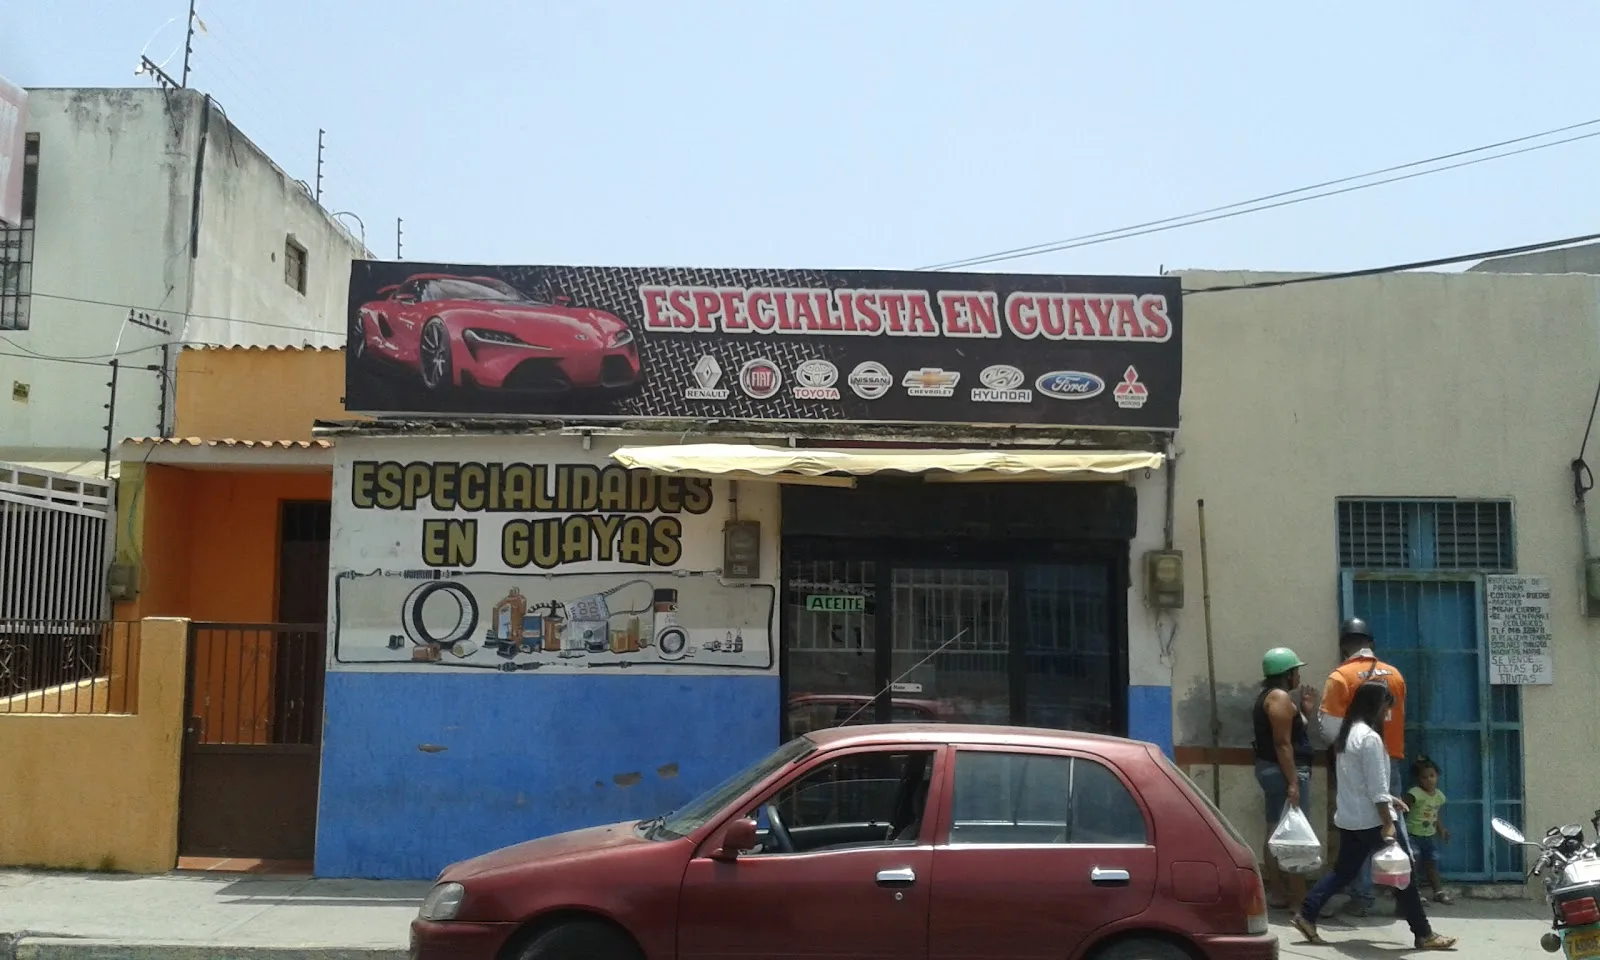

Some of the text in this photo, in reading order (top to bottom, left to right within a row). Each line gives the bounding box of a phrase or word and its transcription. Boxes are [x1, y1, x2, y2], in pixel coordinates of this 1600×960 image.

[639, 285, 1172, 343] ESPECIALISTA EN GUAYAS
[752, 371, 771, 387] FIAT
[1051, 375, 1090, 393] Ford
[687, 390, 728, 399] RENAULT
[794, 389, 839, 399] TOYOTA
[973, 390, 1031, 401] HYUNDAI
[352, 461, 712, 513] ESPECIALIDADES
[422, 515, 682, 568] EN GUAYAS
[811, 596, 863, 611] ACEITE
[1532, 663, 1545, 673] DE
